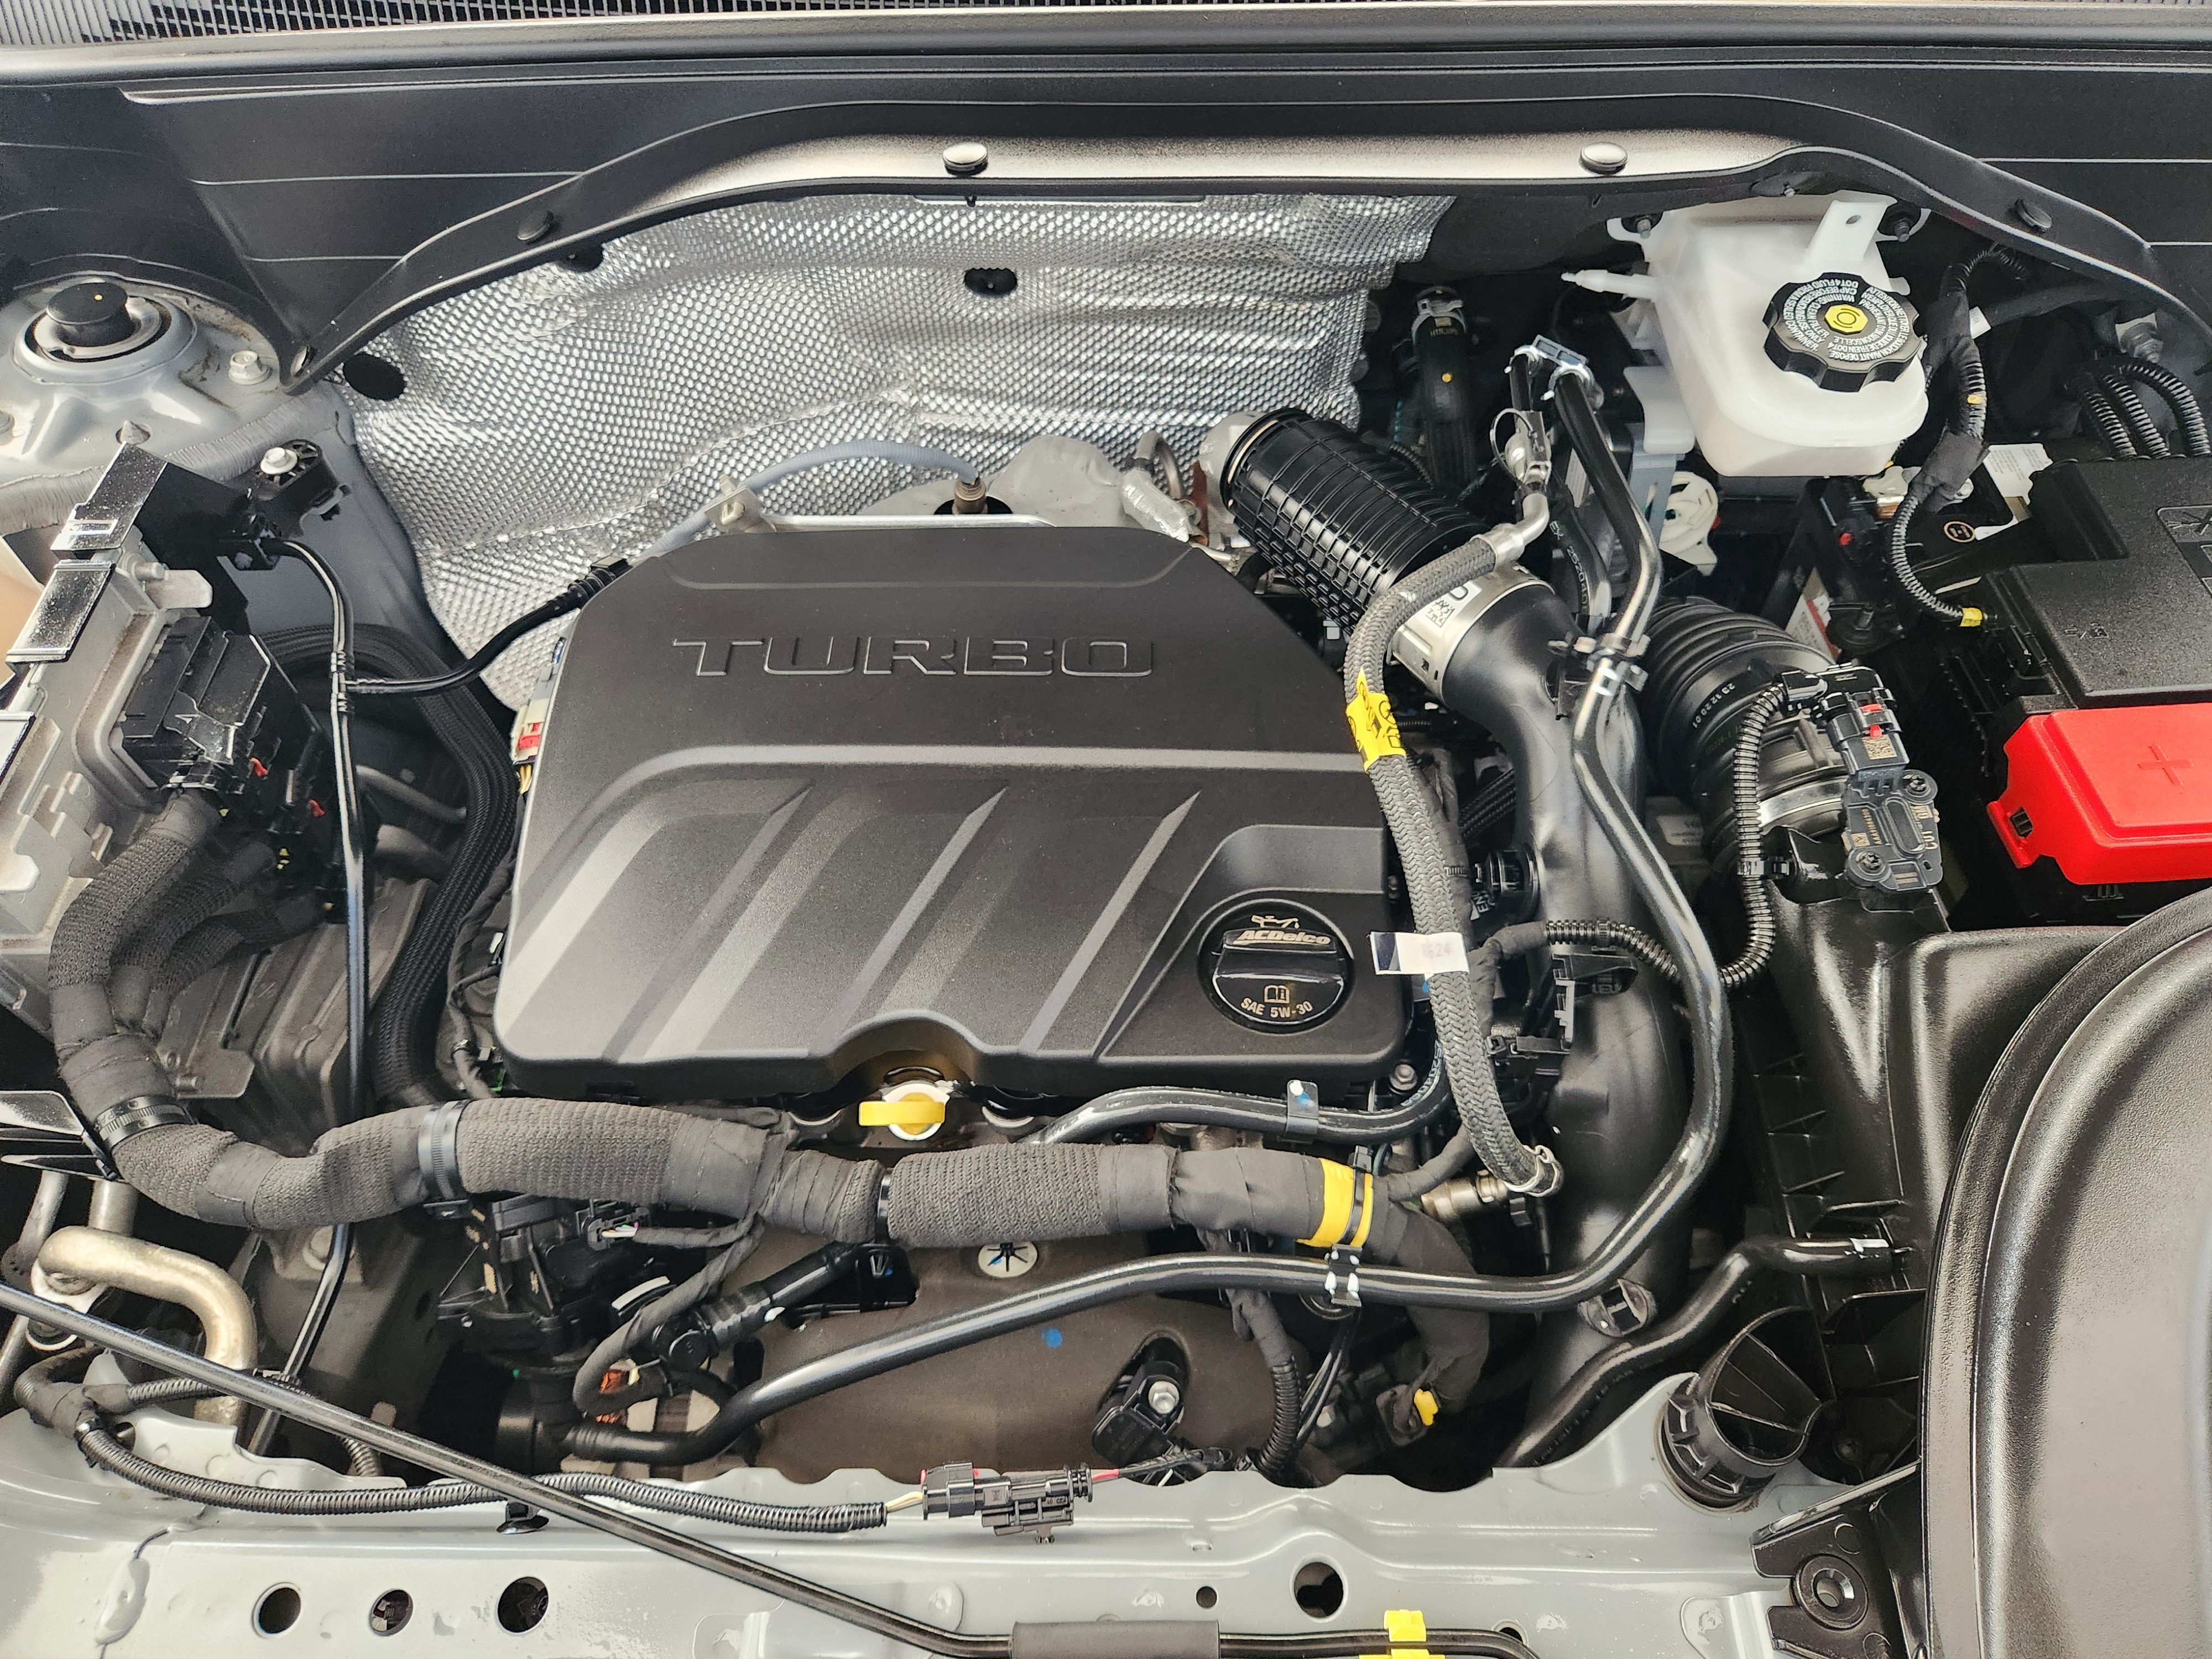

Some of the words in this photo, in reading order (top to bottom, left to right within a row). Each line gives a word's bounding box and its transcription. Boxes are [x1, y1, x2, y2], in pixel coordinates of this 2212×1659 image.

[1811, 279, 1835, 289] FLUID
[1840, 279, 1859, 288] DOT
[1791, 283, 1814, 298] FROM
[1808, 286, 1839, 299] BEFORE
[1839, 286, 1858, 295] CAP
[1783, 299, 1797, 320] SEALED
[1807, 301, 1822, 319] CLEAN
[1858, 298, 1885, 325] PROVENANT
[1796, 319, 1810, 331] USE
[1887, 317, 1898, 326] QUE
[1893, 307, 1908, 332] NETTOYER
[1807, 319, 1830, 338] FILLER
[1887, 326, 1898, 334] DU
[1804, 328, 1825, 343] ONLY
[1860, 332, 1880, 344] BIDON
[1832, 343, 1848, 352] DOT
[1848, 345, 1870, 353] FREIN
[1867, 343, 1880, 351] DE
[1879, 337, 1906, 356] BOUCHON
[1860, 350, 1882, 361] AVANT
[674, 636, 1154, 677] TURBO
[1237, 930, 1331, 945] ACDelco
[1240, 997, 1265, 1016] SAE
[1270, 1000, 1313, 1018] 5W-30
